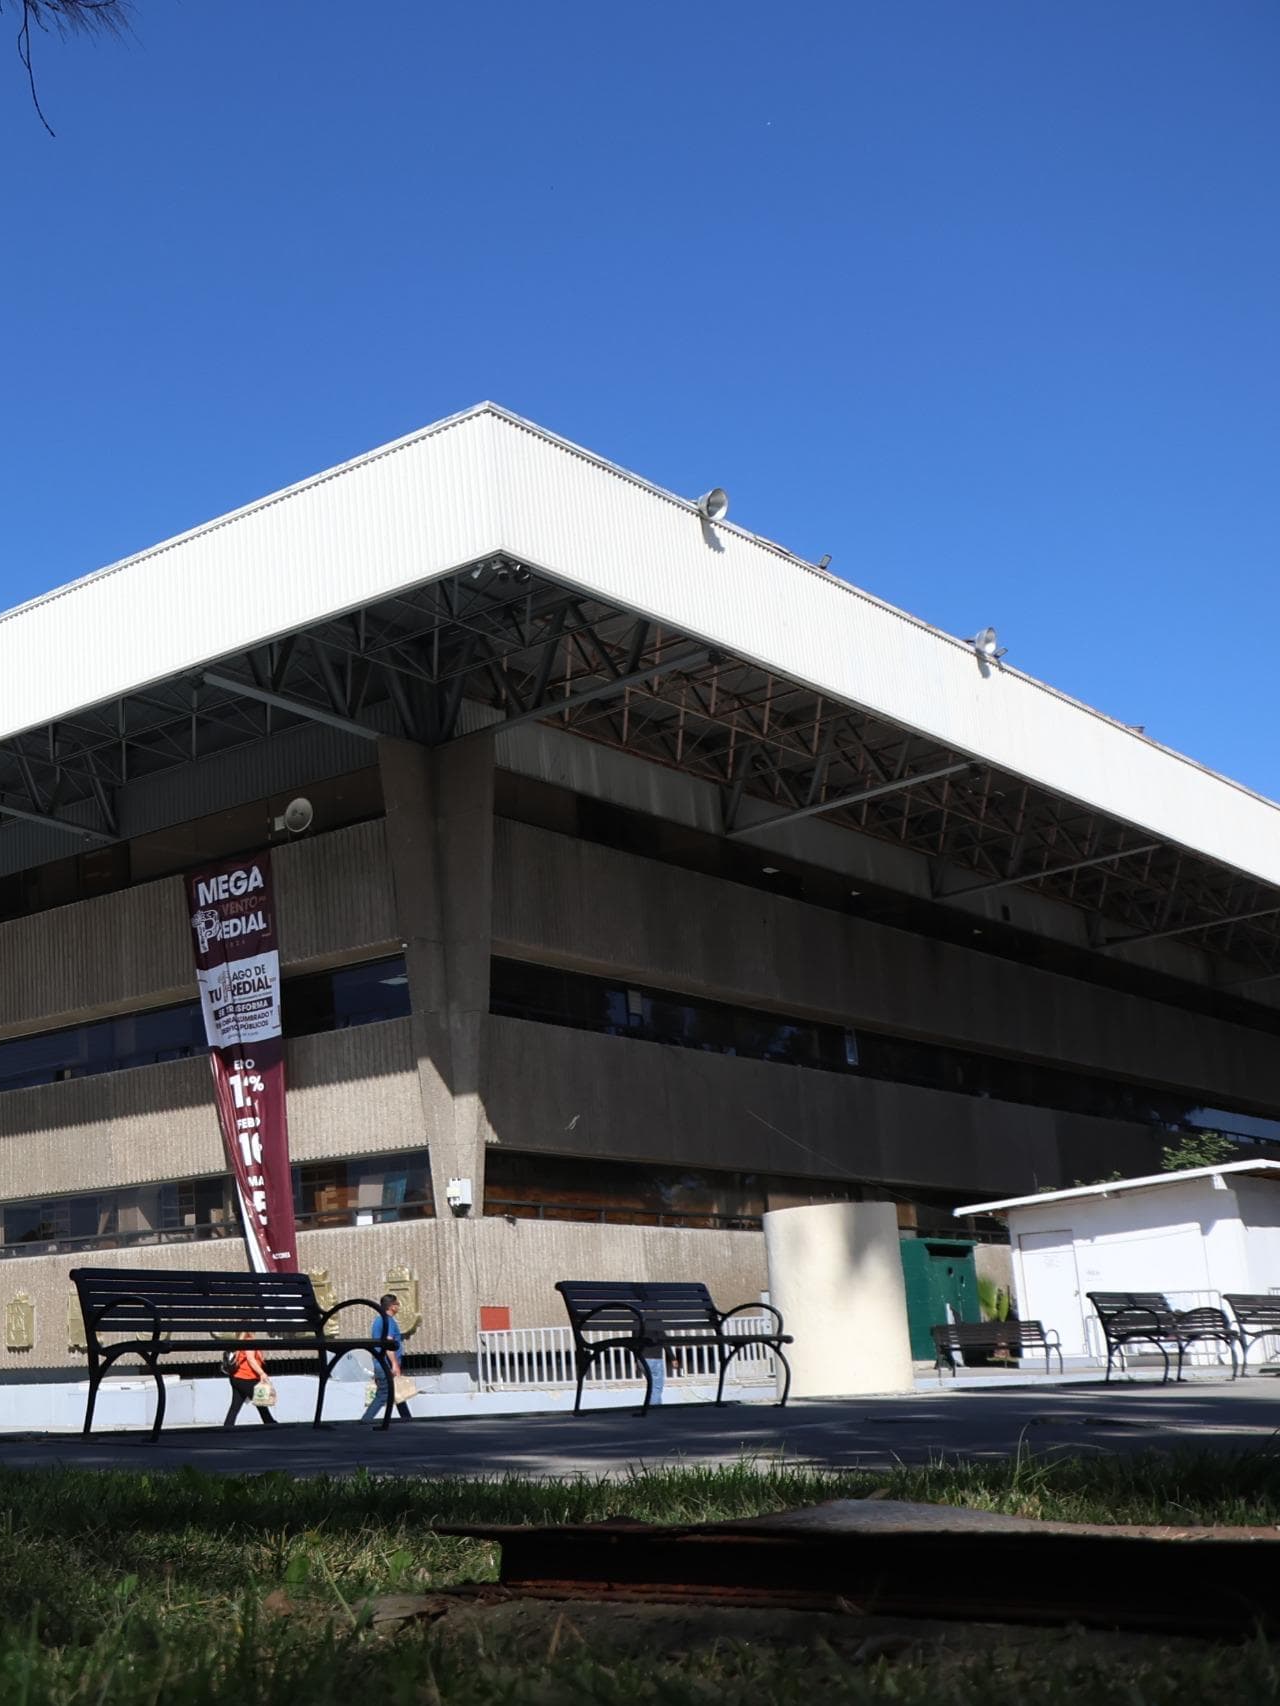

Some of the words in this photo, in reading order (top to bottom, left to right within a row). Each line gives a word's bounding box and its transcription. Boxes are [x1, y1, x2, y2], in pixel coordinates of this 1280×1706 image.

[198, 866, 264, 907] MEGA
[255, 964, 266, 976] DE
[208, 987, 222, 1003] TU
